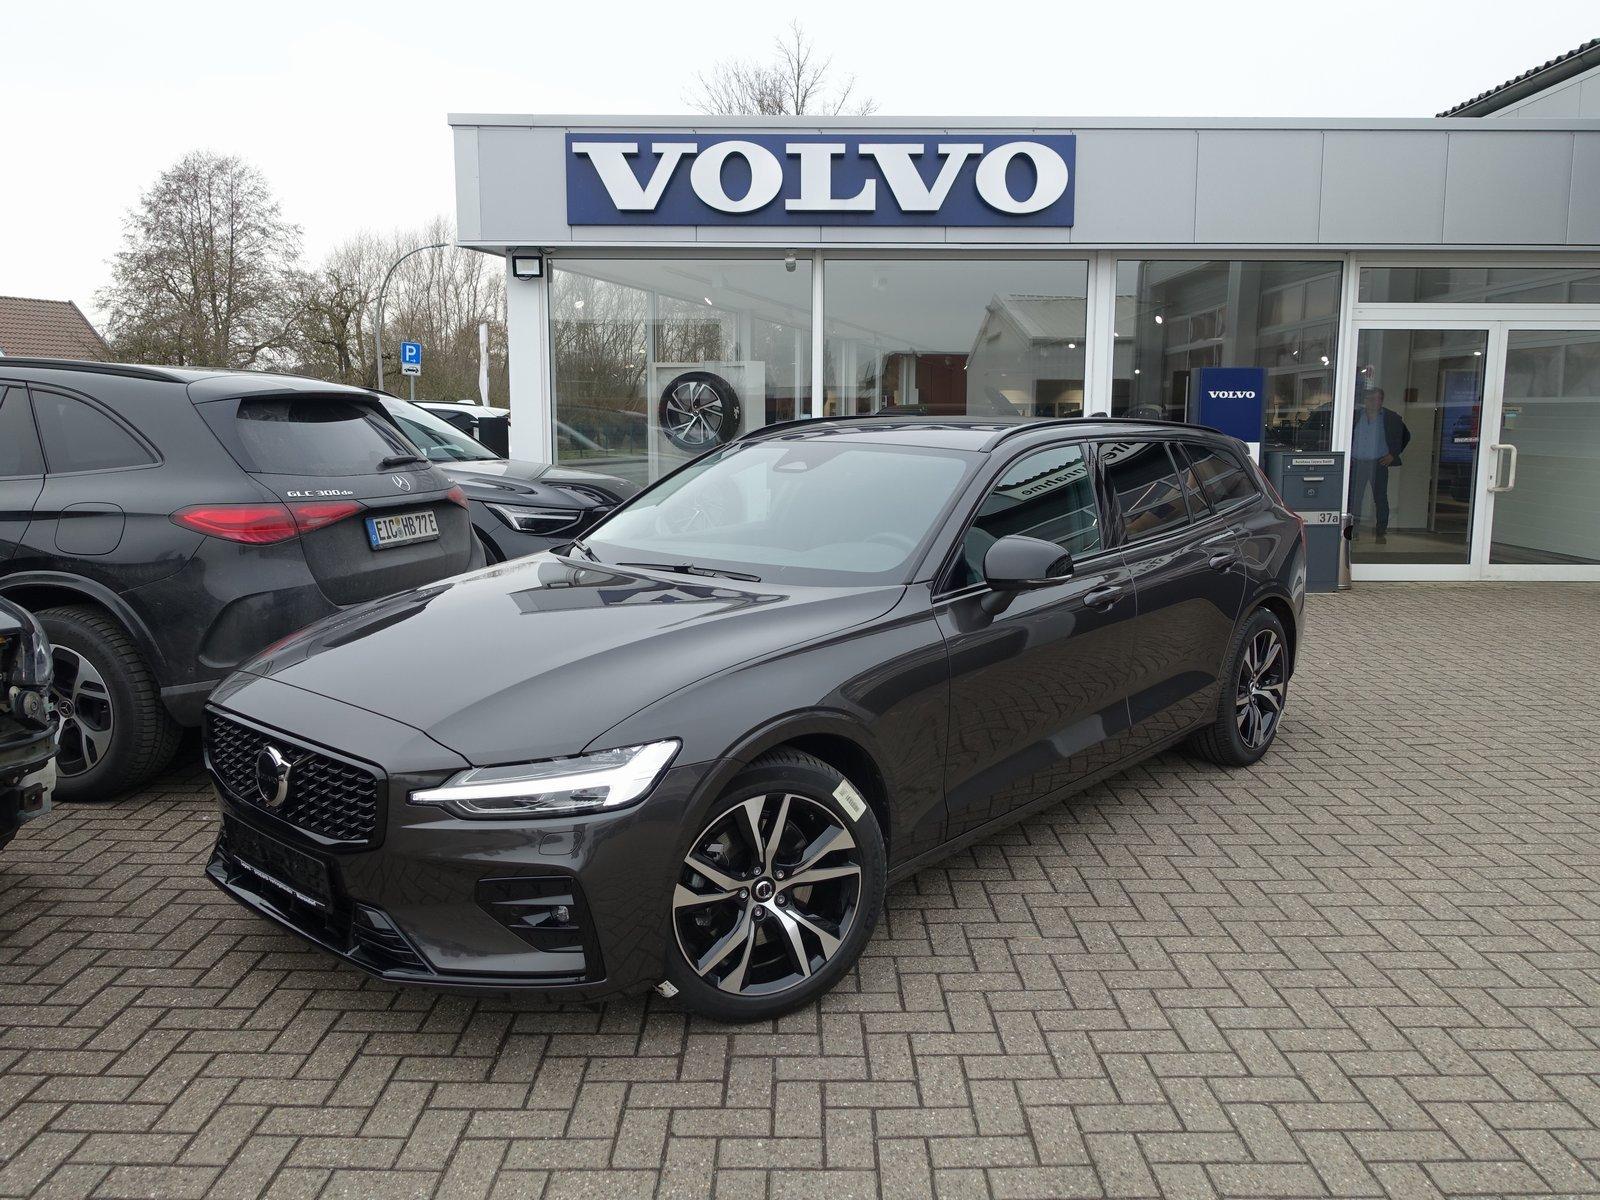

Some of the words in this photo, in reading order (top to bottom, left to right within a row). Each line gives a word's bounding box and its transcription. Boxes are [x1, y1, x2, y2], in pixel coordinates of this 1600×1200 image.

[571, 140, 1069, 214] VOLVO
[406, 345, 416, 361] P
[1208, 390, 1256, 399] VOLVO
[1319, 513, 1339, 523] 37a
[375, 519, 398, 541] EIC
